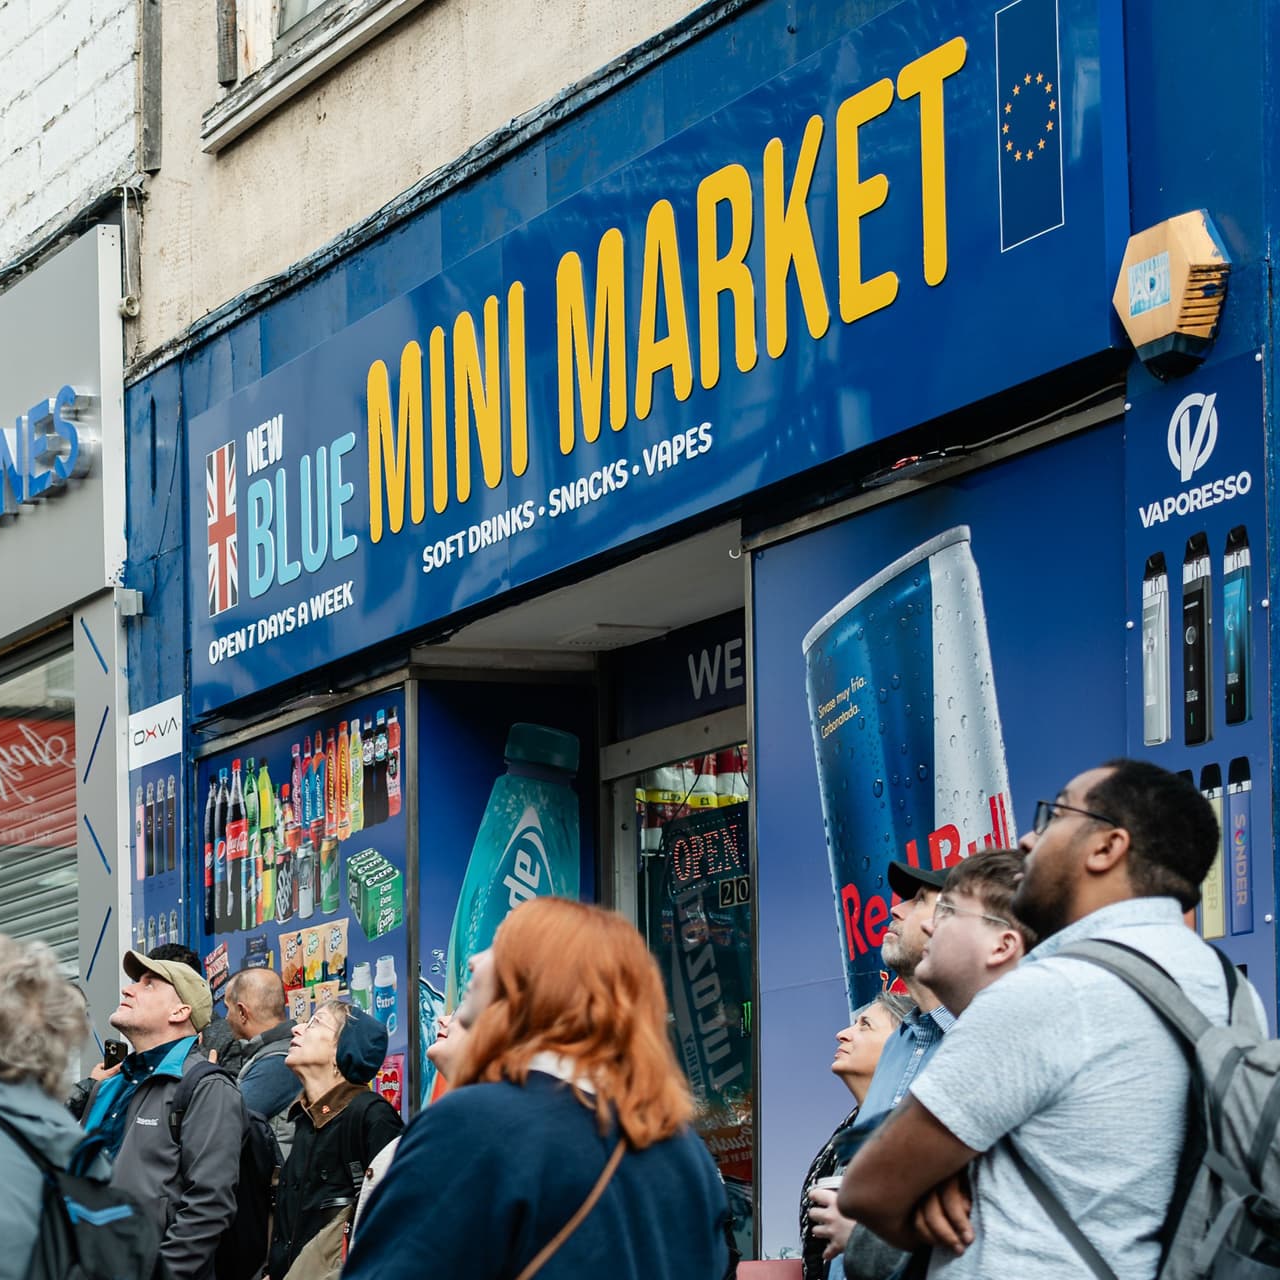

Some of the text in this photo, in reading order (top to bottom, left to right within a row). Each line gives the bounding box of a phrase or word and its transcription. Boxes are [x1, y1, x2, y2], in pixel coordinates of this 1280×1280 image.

[366, 35, 970, 545] MINI MARKET
[246, 414, 284, 477] NEW
[247, 431, 359, 599] BLUE
[422, 422, 713, 574] SOFT DRINKS SNACKS VAPES
[1138, 471, 1252, 530] VAPORESSO
[208, 580, 354, 666] OPEN 7 DAYS A WEEK
[673, 824, 740, 882] OPEN
[722, 880, 748, 905] 20
[1234, 814, 1247, 905] SONDER
